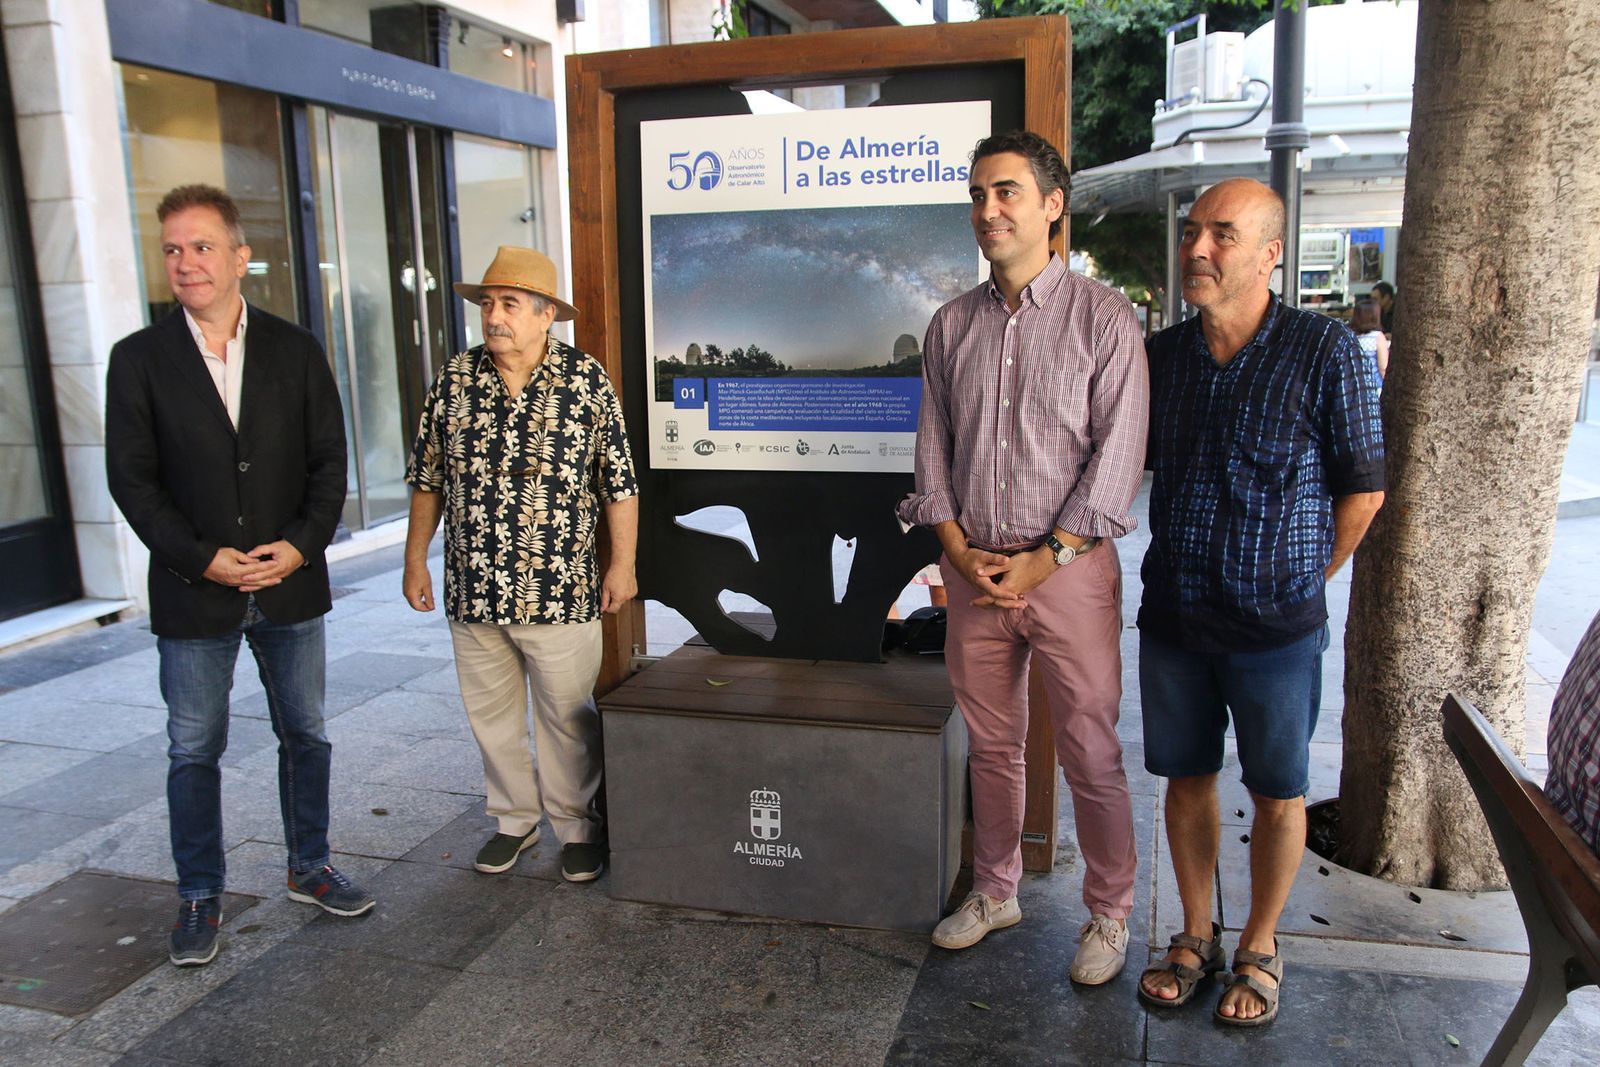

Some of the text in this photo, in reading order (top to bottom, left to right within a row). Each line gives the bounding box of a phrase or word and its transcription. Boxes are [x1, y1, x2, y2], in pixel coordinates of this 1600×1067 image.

[728, 147, 766, 161] AÑOS
[796, 134, 939, 161] De Almería
[667, 150, 724, 191] 50
[796, 159, 969, 188] a las estrellas
[681, 387, 696, 399] 01
[765, 445, 790, 453] CSIC
[733, 841, 803, 859] ALMERÍA
[749, 857, 785, 868] CIUDAD
